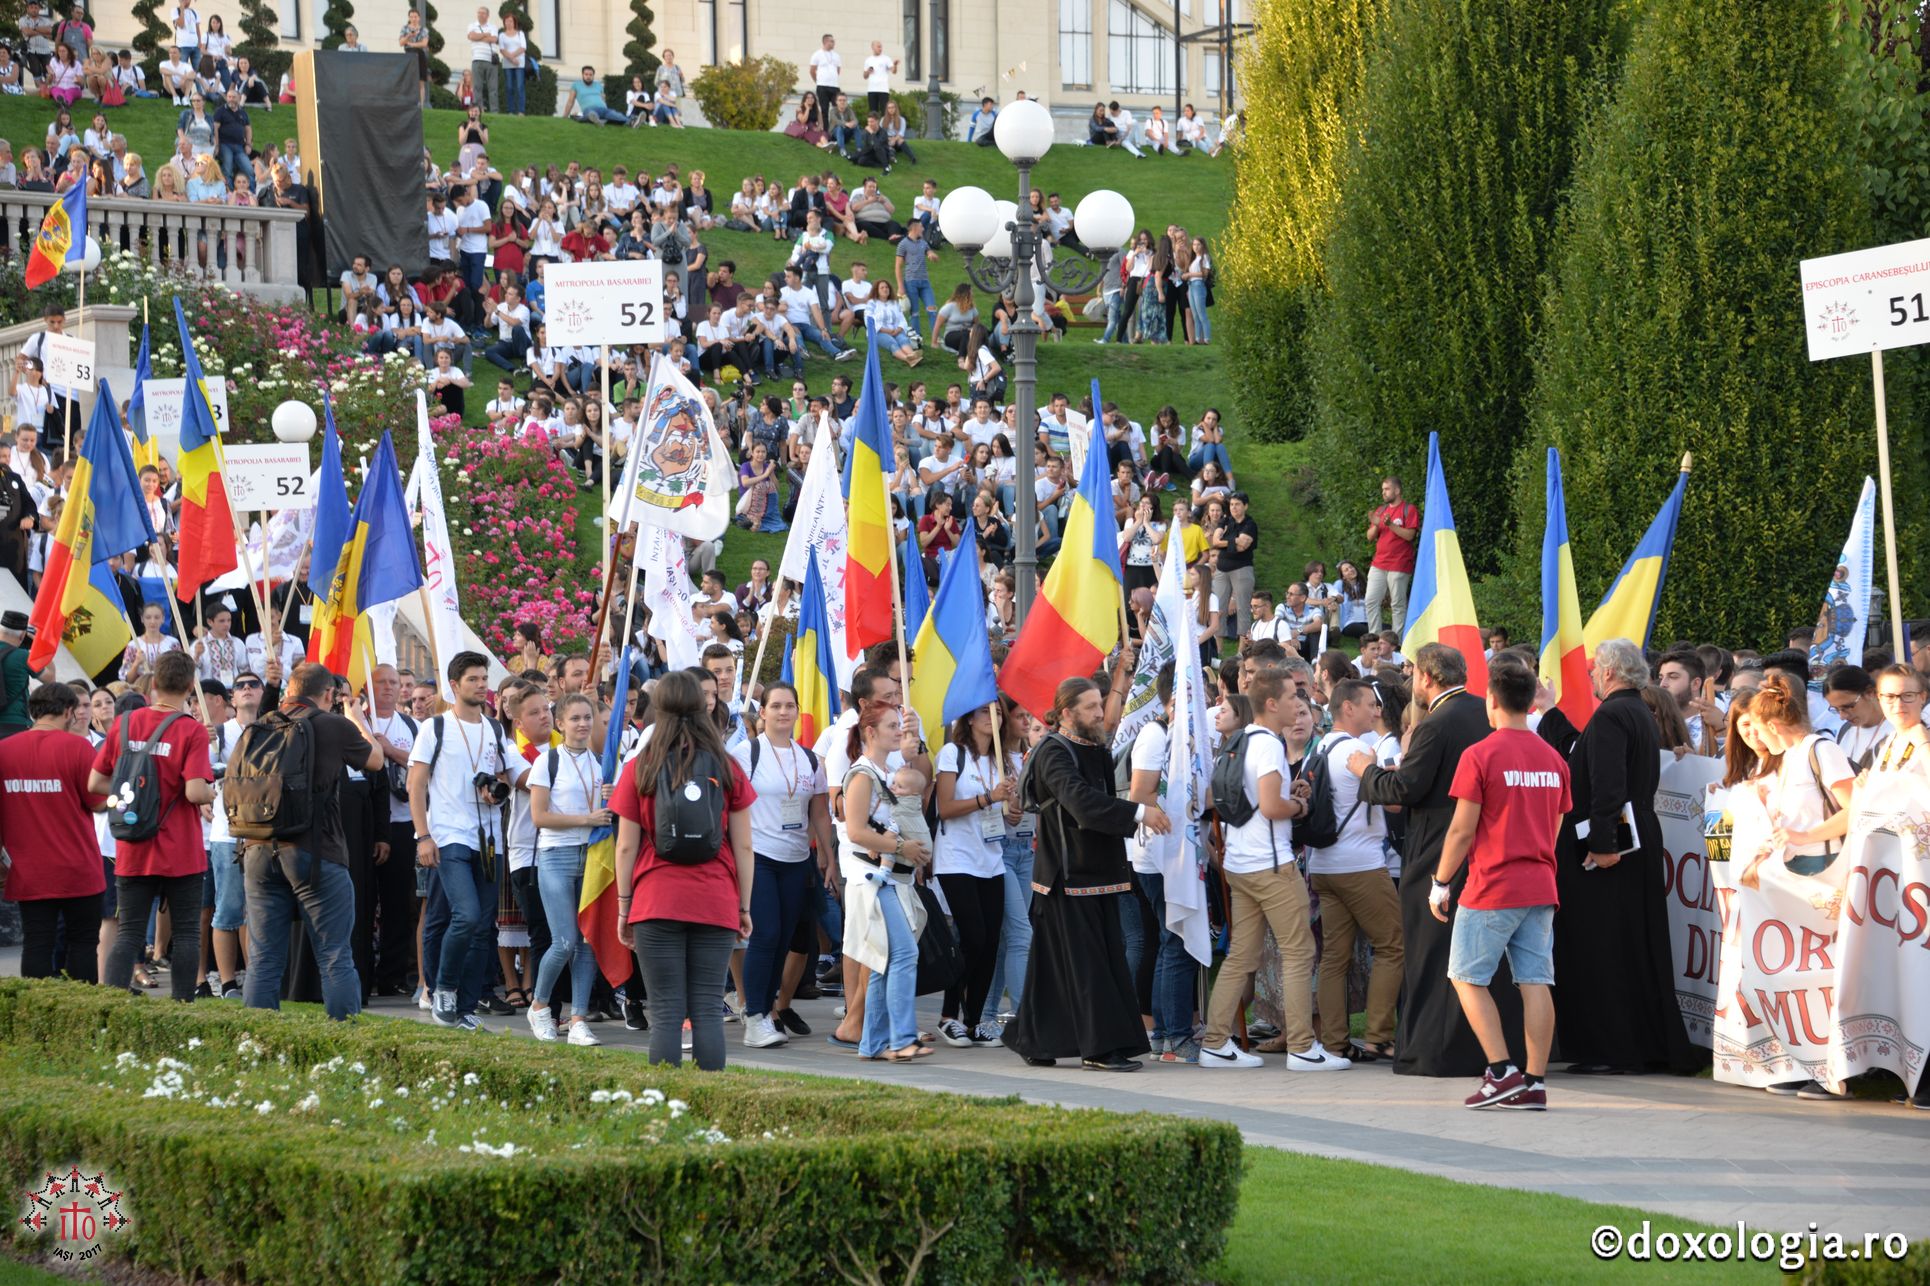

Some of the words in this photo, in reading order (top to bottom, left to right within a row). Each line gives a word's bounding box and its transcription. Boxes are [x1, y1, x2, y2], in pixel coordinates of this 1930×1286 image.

[555, 278, 605, 288] MITROPOLIA
[607, 277, 652, 287] BASARABIEI
[1805, 276, 1850, 291] EPISCOPIA
[621, 302, 655, 327] 52
[1889, 292, 1930, 327] 51
[76, 363, 91, 381] 53
[211, 404, 223, 420] 3
[276, 476, 305, 496] 52
[4, 778, 62, 793] VOLUNTAR
[1503, 770, 1560, 788] VOLUNTAR
